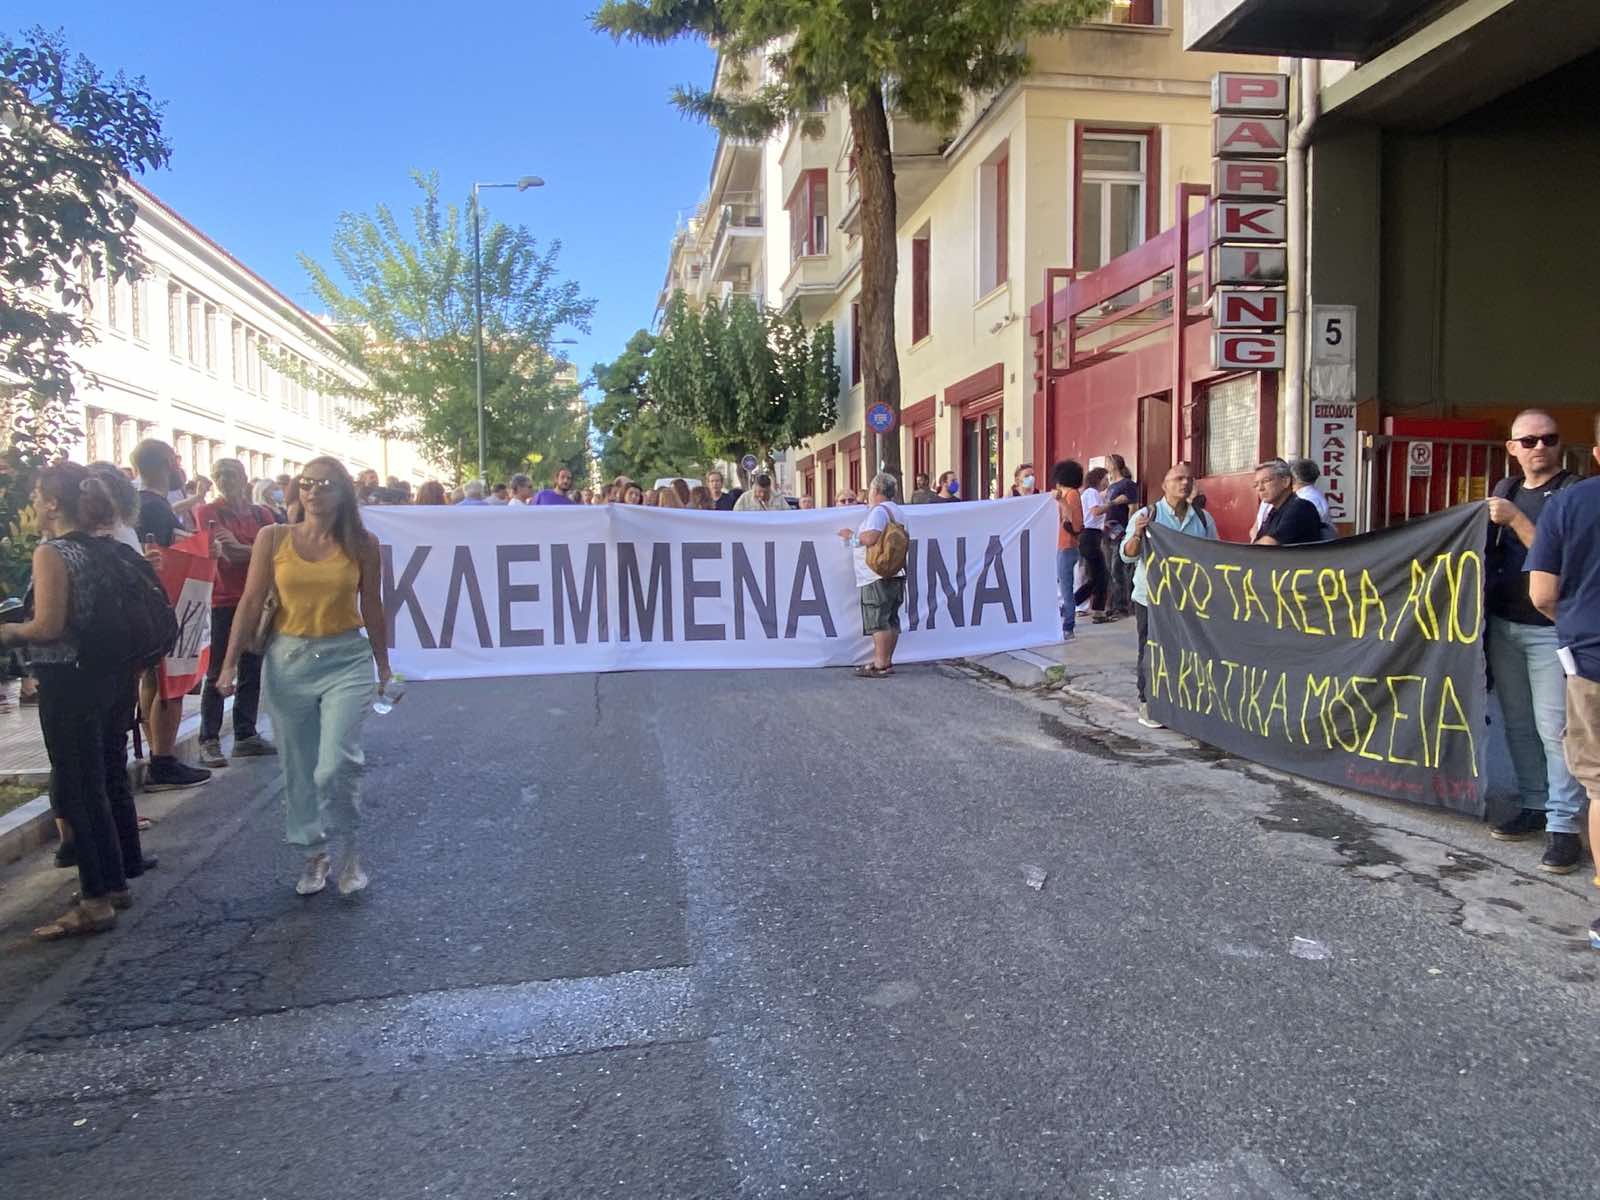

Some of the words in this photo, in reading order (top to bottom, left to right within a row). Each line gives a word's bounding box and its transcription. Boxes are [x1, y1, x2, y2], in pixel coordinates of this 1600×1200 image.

[1223, 77, 1282, 364] PARKING
[1325, 318, 1343, 346] 5
[1314, 404, 1354, 418] ΕΙΣΟΔΟΣ
[379, 541, 838, 649] ΚΛΕΜΜΕΝΑ
[863, 529, 1032, 637] ΙΝΑΙ
[1214, 564, 1269, 623] ΤΑ
[1270, 568, 1387, 641] ΚΕΡΙΑ
[1389, 550, 1482, 645] ΑΠΟ
[1146, 639, 1173, 703] ΤΑ
[1177, 647, 1294, 744] ΚΡΑΤΙΚΑ
